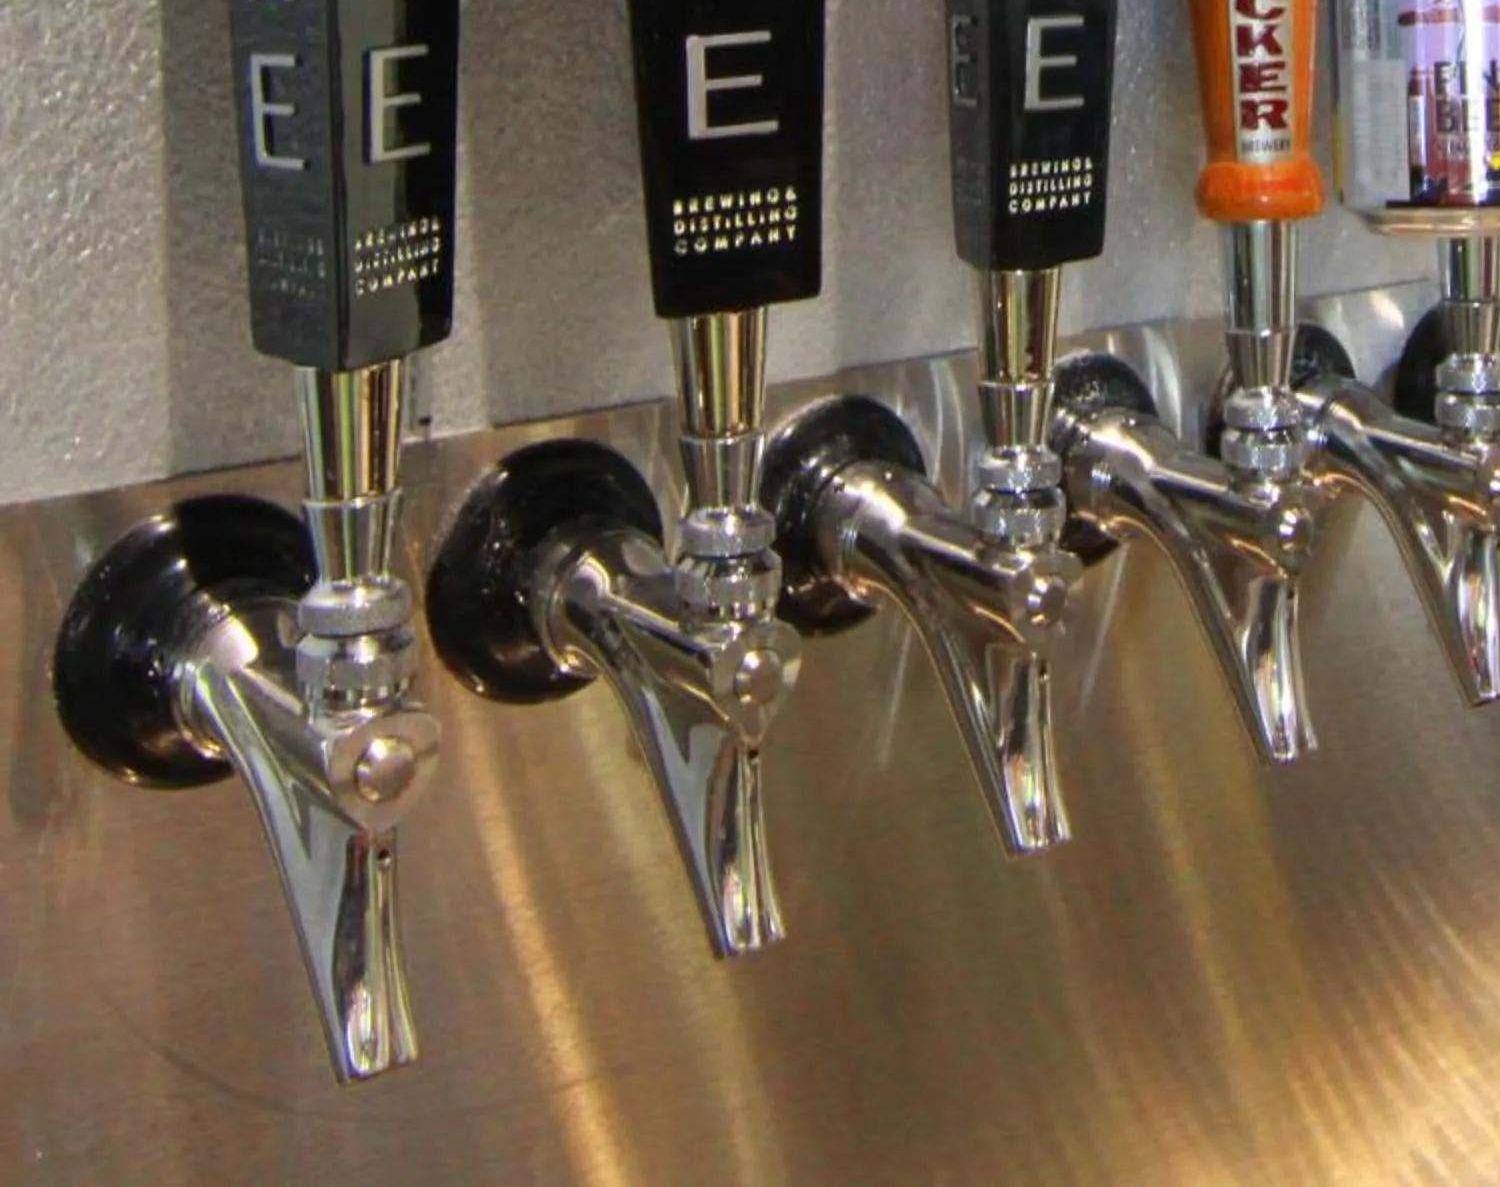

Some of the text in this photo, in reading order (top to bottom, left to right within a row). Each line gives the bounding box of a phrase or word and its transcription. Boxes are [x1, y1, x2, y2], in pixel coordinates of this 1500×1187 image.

[1009, 173, 1093, 196] DISTILLING
[1008, 192, 1092, 215] COMPANY
[673, 204, 798, 236] DISTILLING
[674, 224, 797, 257] COMPANY
